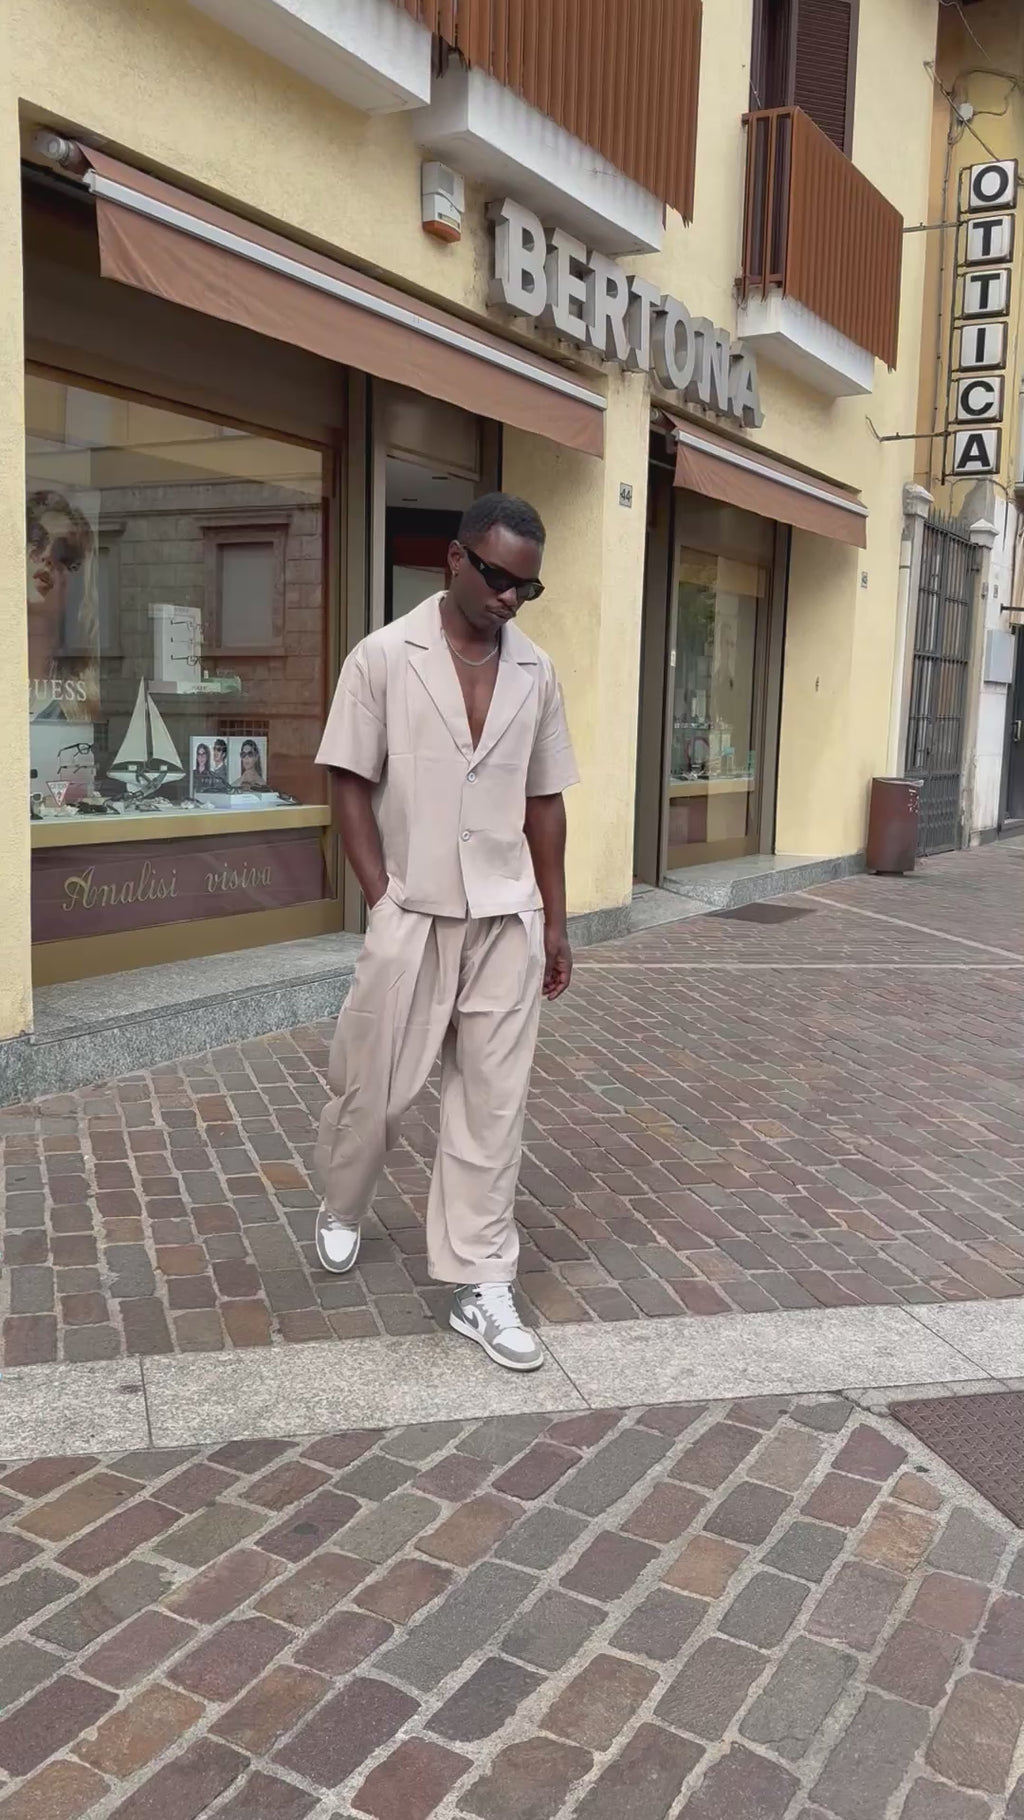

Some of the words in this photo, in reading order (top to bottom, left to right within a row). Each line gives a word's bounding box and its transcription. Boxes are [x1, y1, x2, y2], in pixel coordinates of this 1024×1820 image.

[493, 197, 764, 428] BERTONA
[956, 164, 1010, 470] OTTICA
[29, 678, 87, 701] UESS
[63, 861, 178, 911] Analisi
[205, 862, 272, 893] visiva
